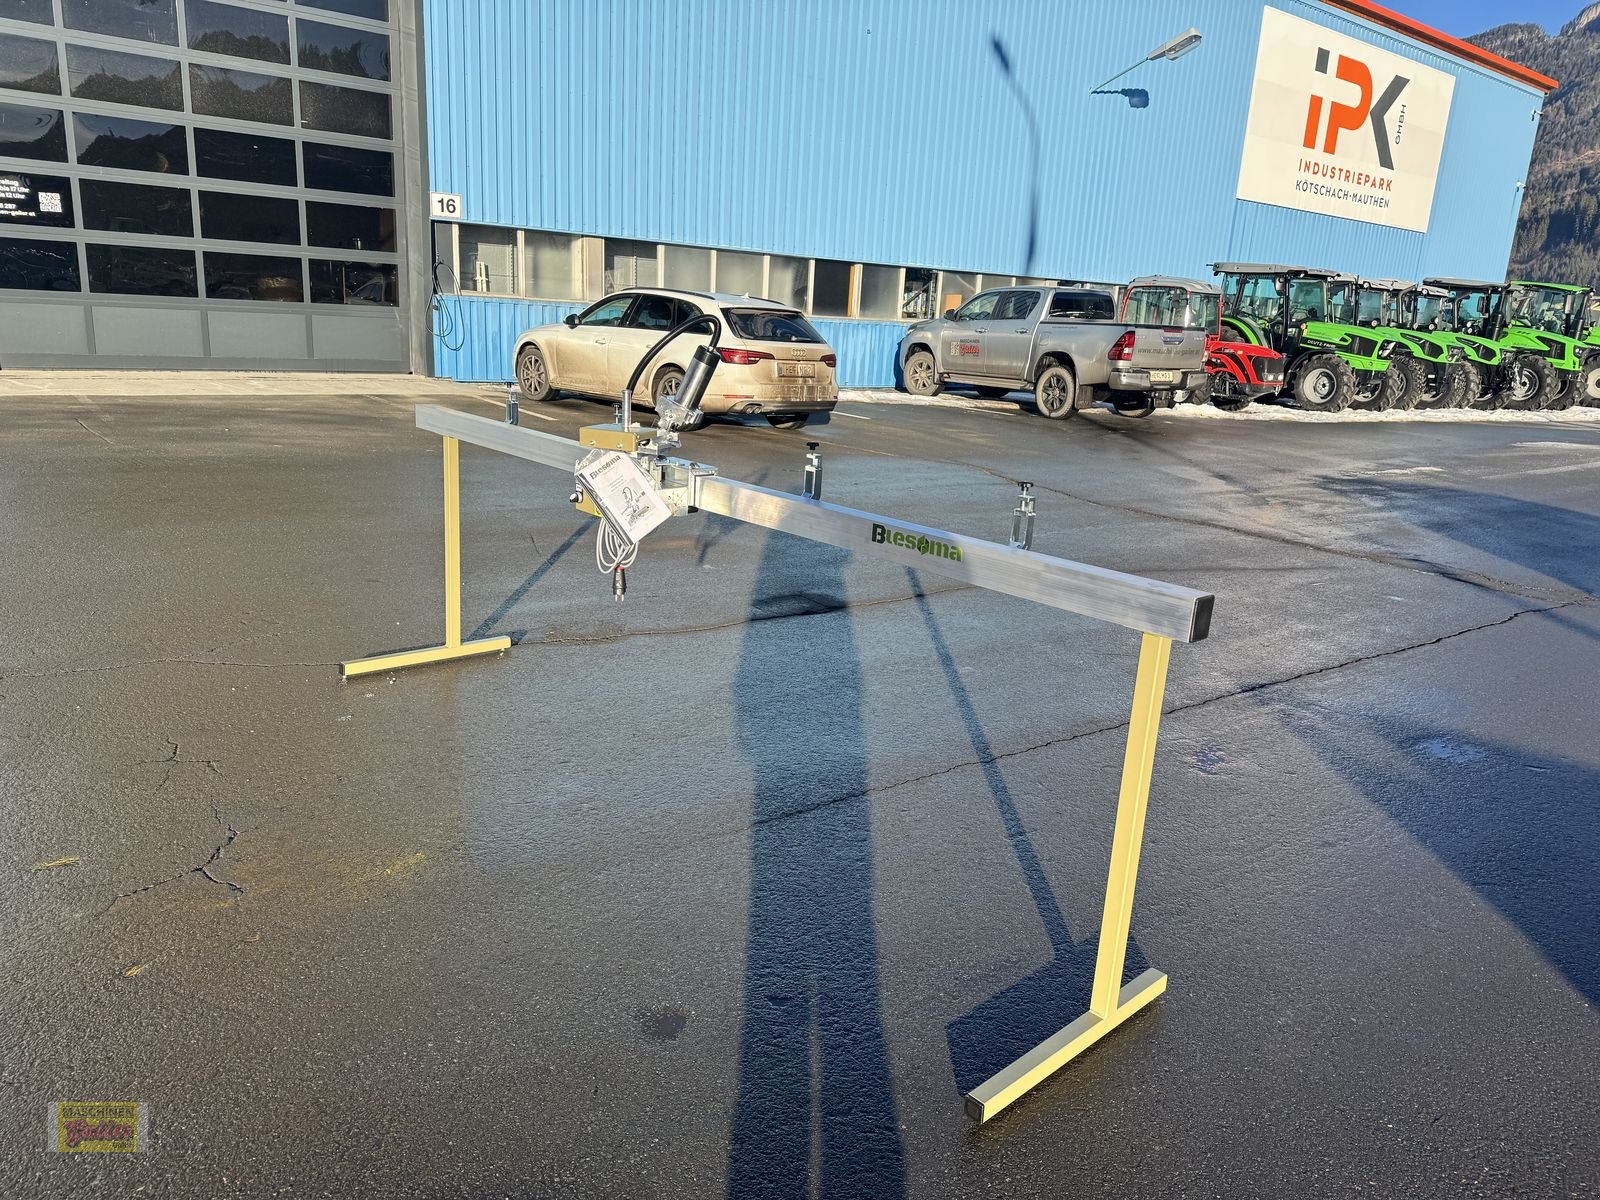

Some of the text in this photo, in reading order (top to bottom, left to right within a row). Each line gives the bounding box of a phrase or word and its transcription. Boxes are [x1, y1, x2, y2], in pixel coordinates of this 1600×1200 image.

[1395, 104, 1407, 145] GMBH
[1298, 158, 1393, 192] INDUSTRIEPARK
[437, 197, 456, 213] 16
[1295, 179, 1390, 209] KÖTSCHACH-MAUTHEN
